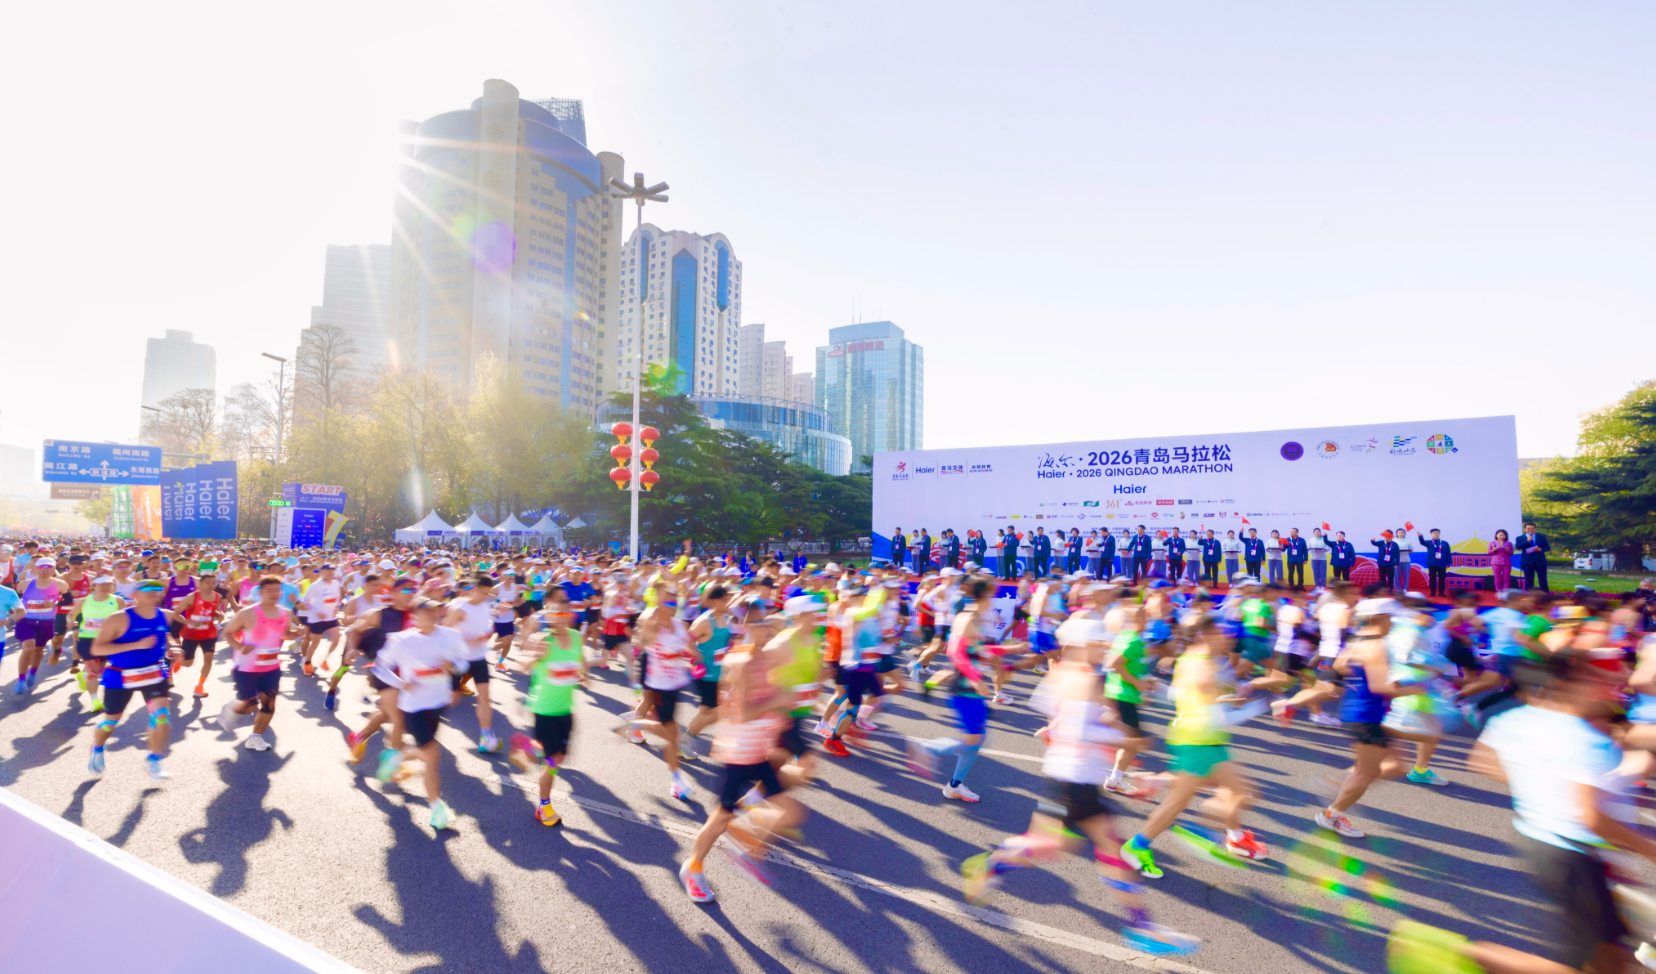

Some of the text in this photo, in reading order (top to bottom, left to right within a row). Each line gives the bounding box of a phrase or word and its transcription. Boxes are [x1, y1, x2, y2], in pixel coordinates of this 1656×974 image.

[58, 445, 91, 454] 南京路
[112, 448, 150, 458] 福州南路
[1088, 444, 1231, 466] 2026青岛马拉松
[44, 462, 78, 470] 闽江路
[130, 466, 160, 474] 东海西路
[1038, 463, 1233, 478] Haier 2026 QINGDAO MARATHON
[301, 484, 343, 495] START
[1114, 484, 1146, 494] Haier
[184, 482, 196, 521] Haier
[199, 480, 213, 520] Haier
[216, 478, 234, 520] Haier
